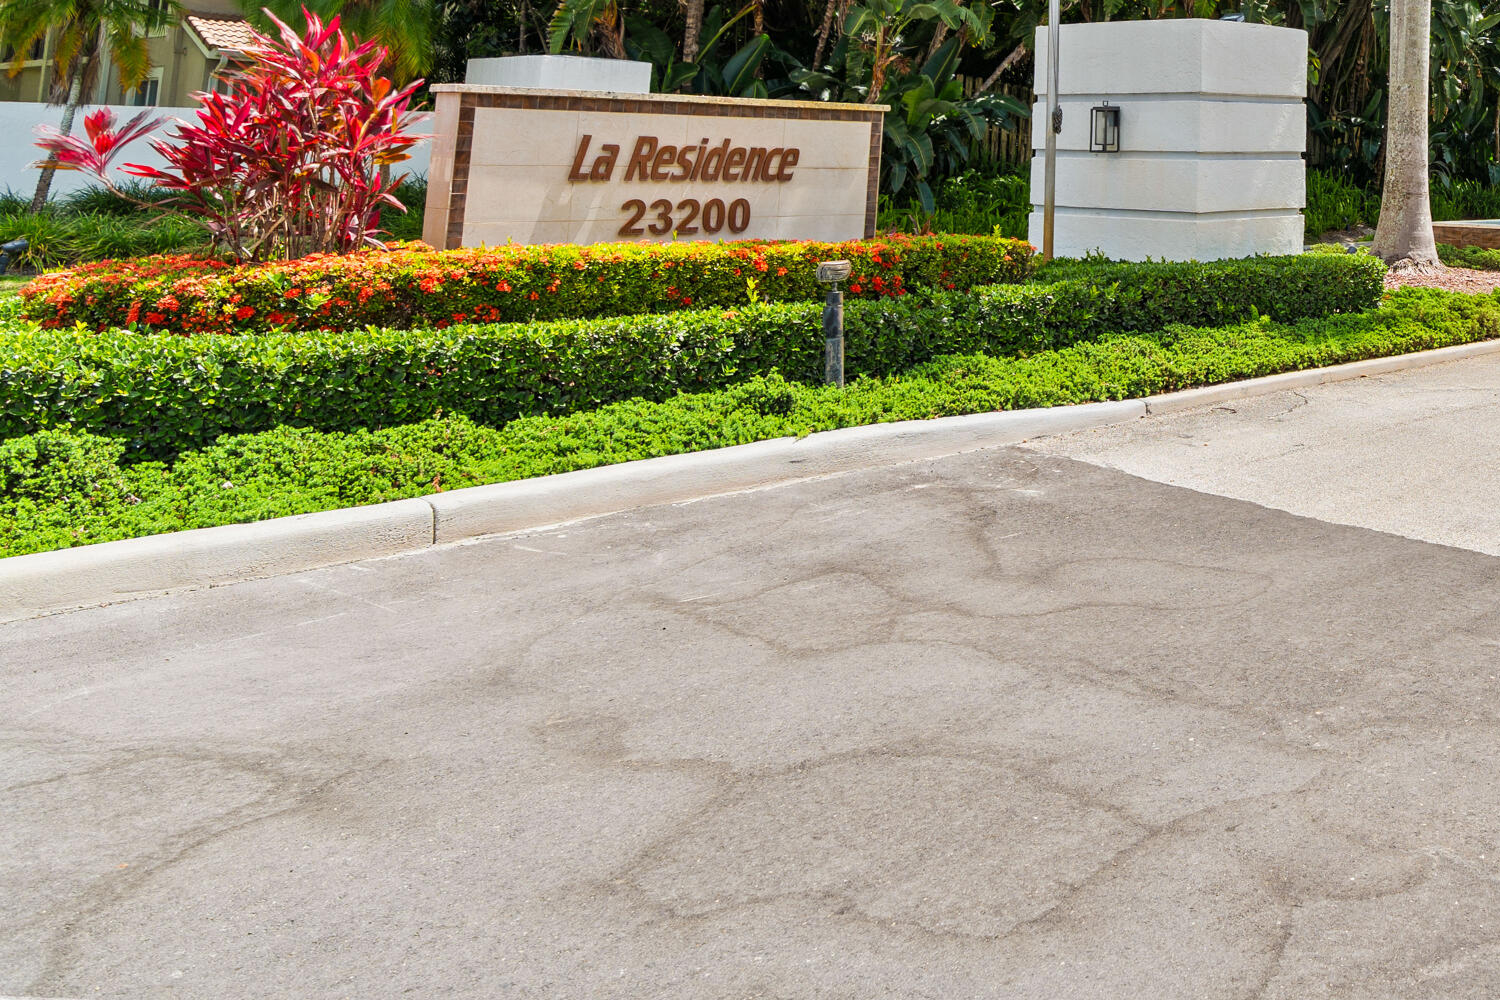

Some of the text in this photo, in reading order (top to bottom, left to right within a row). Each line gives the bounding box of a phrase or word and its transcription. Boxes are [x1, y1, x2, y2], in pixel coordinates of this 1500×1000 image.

[568, 134, 800, 182] La Residence
[618, 198, 751, 236] 23200
